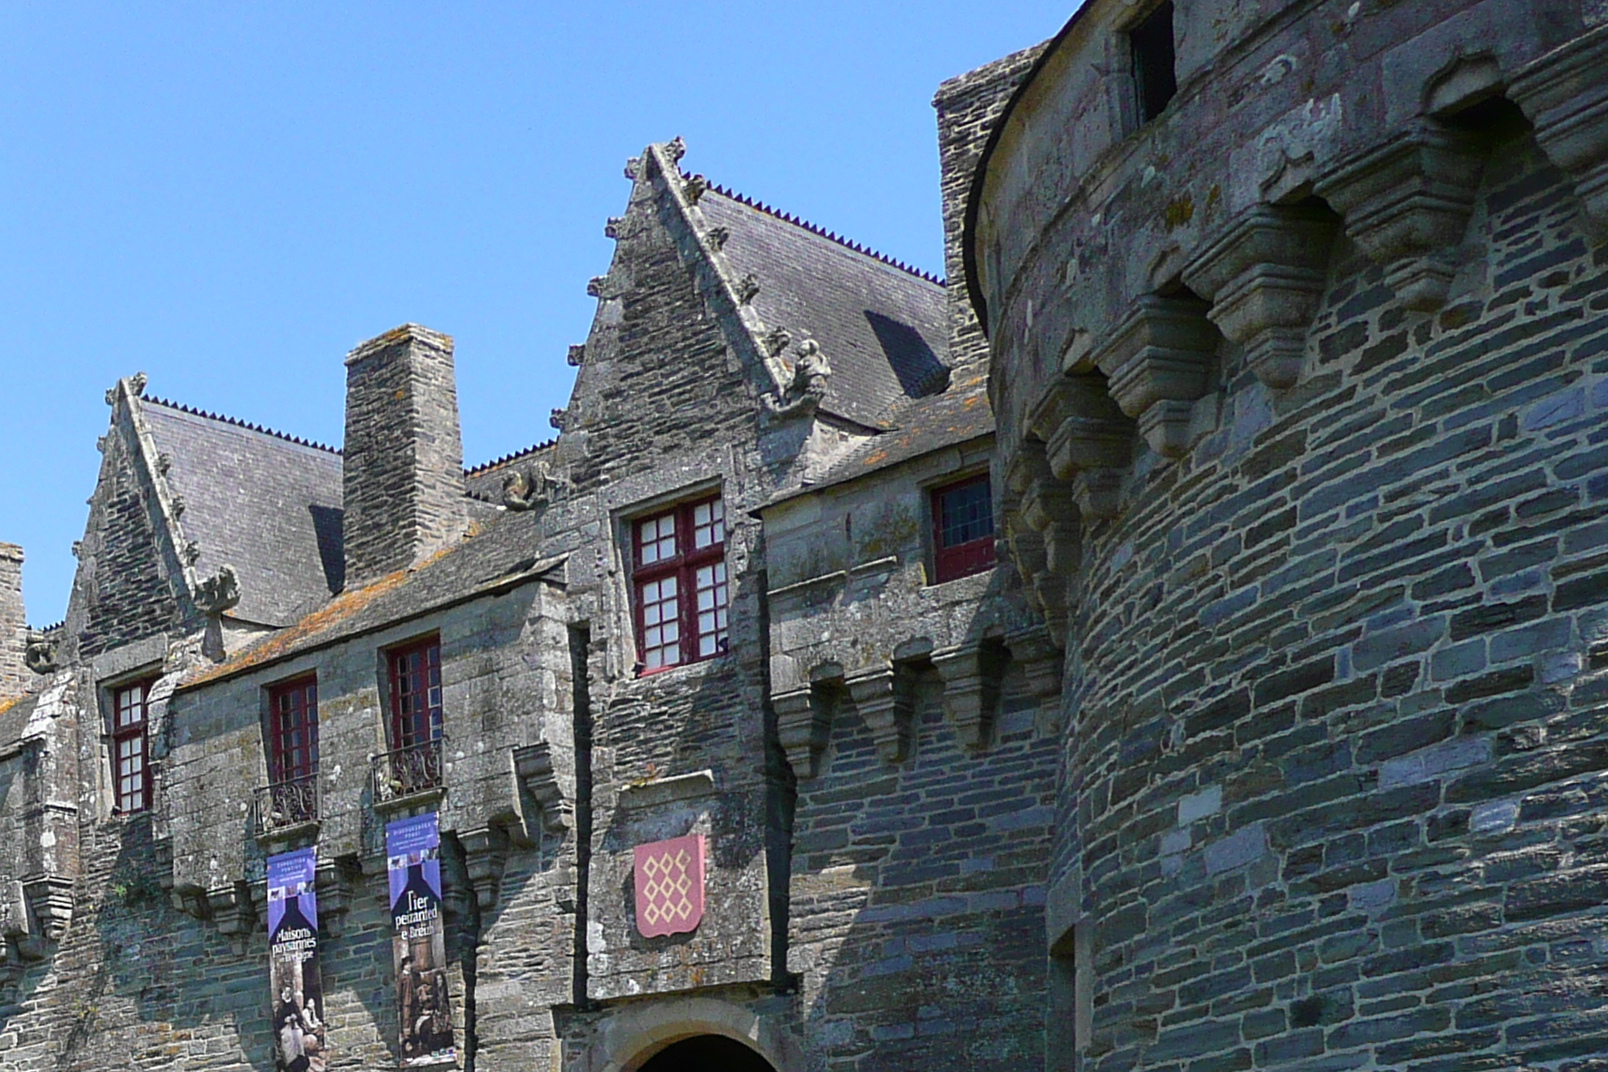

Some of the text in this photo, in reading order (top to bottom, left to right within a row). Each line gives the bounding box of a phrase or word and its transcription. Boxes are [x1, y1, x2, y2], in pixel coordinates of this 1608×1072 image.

[407, 890, 429, 911] Tier
[276, 926, 311, 942] Maisons
[272, 937, 317, 958] paysannes
